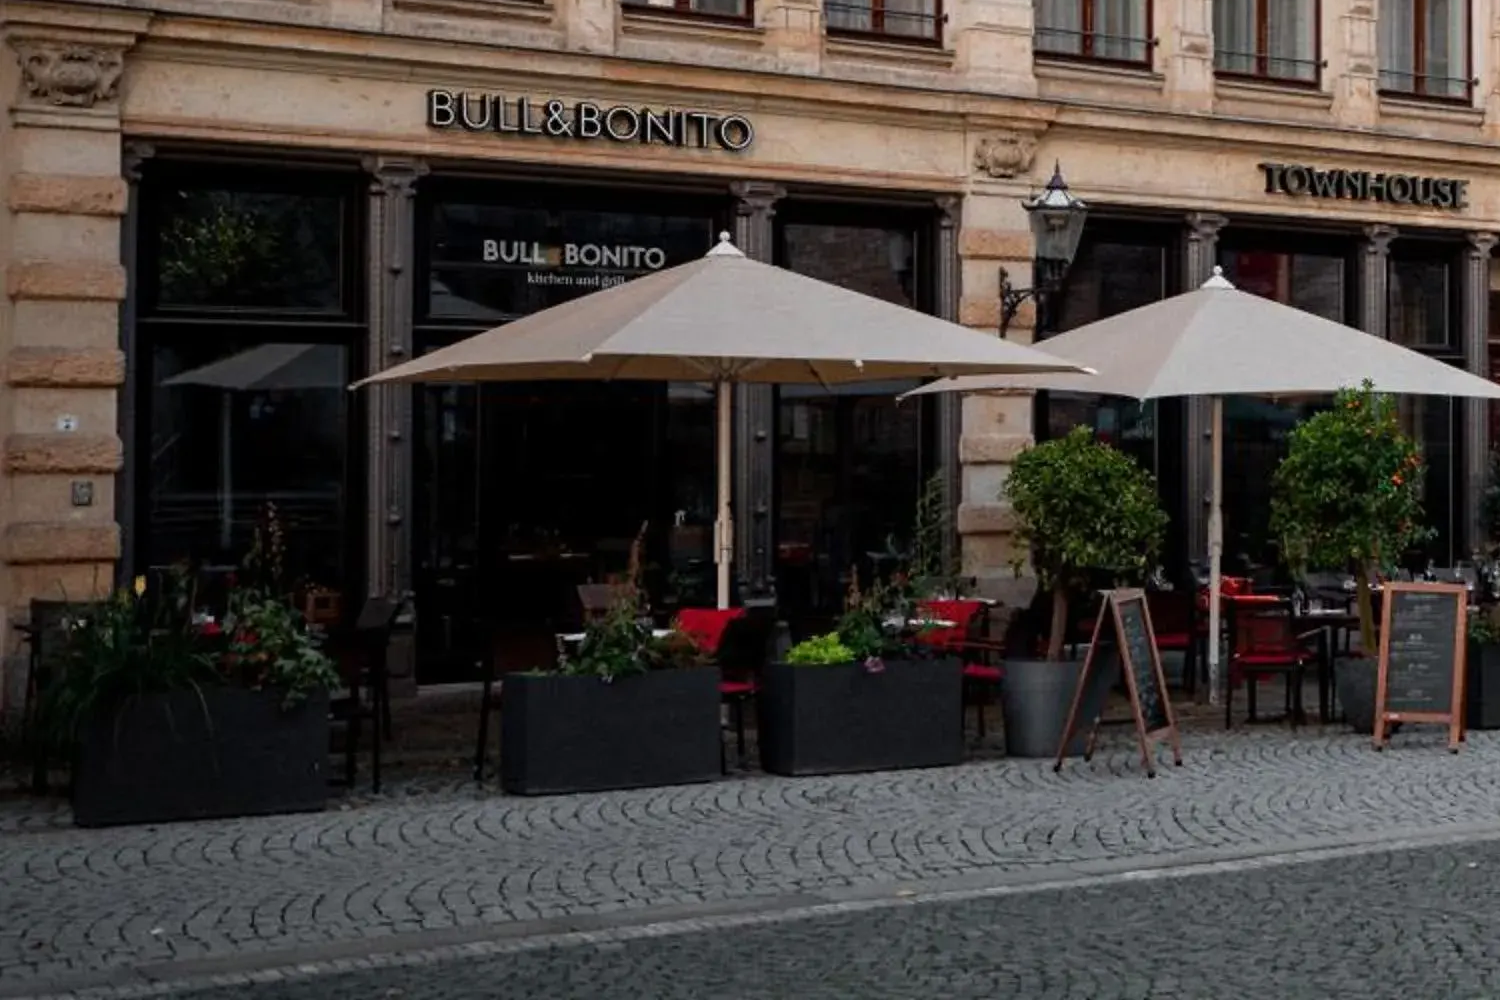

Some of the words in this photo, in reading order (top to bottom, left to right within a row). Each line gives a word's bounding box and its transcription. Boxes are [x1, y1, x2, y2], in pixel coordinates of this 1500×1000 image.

[429, 89, 753, 151] BULL&BONITO
[1258, 163, 1470, 210] TOWNHOUSE
[483, 239, 546, 263] BULL
[565, 243, 666, 269] BONITO
